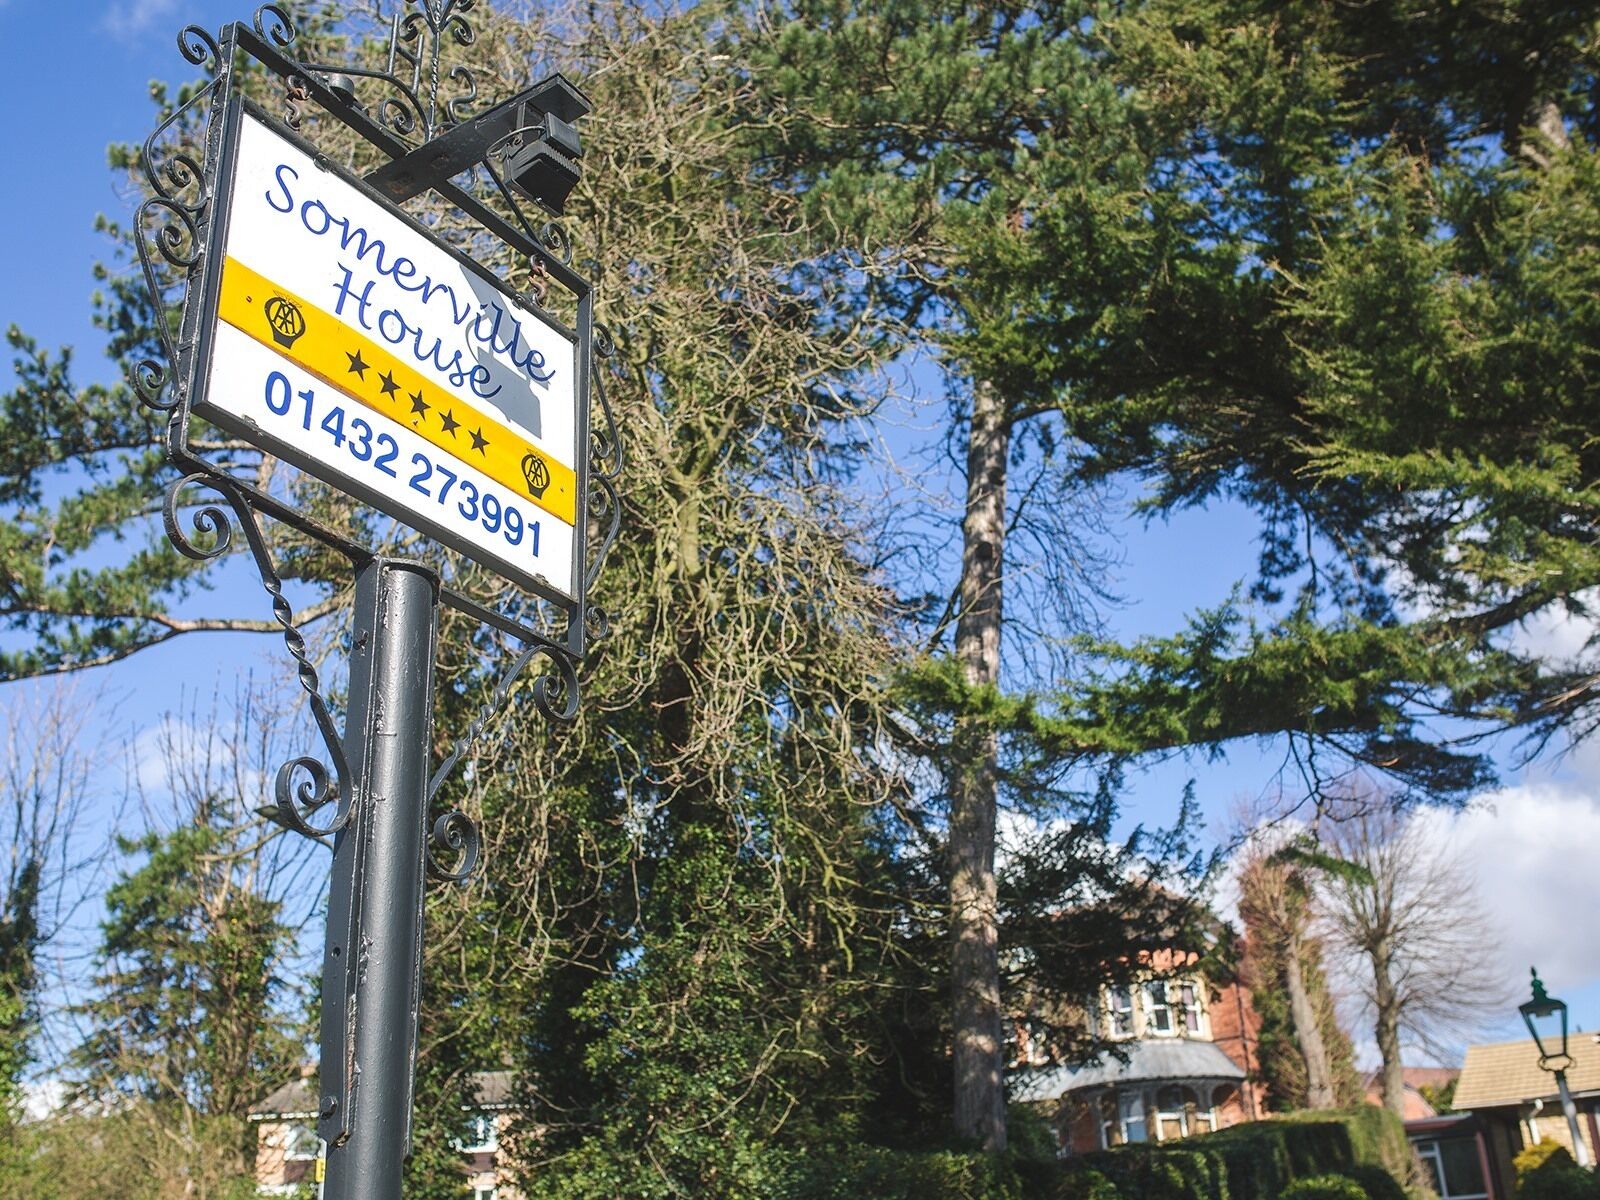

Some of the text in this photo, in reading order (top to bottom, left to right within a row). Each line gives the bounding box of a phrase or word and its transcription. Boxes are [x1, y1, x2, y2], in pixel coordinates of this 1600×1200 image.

[265, 164, 556, 382] Somerville
[269, 300, 300, 337] AA
[332, 262, 502, 398] House
[264, 370, 541, 558] 01432 273991
[525, 457, 547, 489] AA
